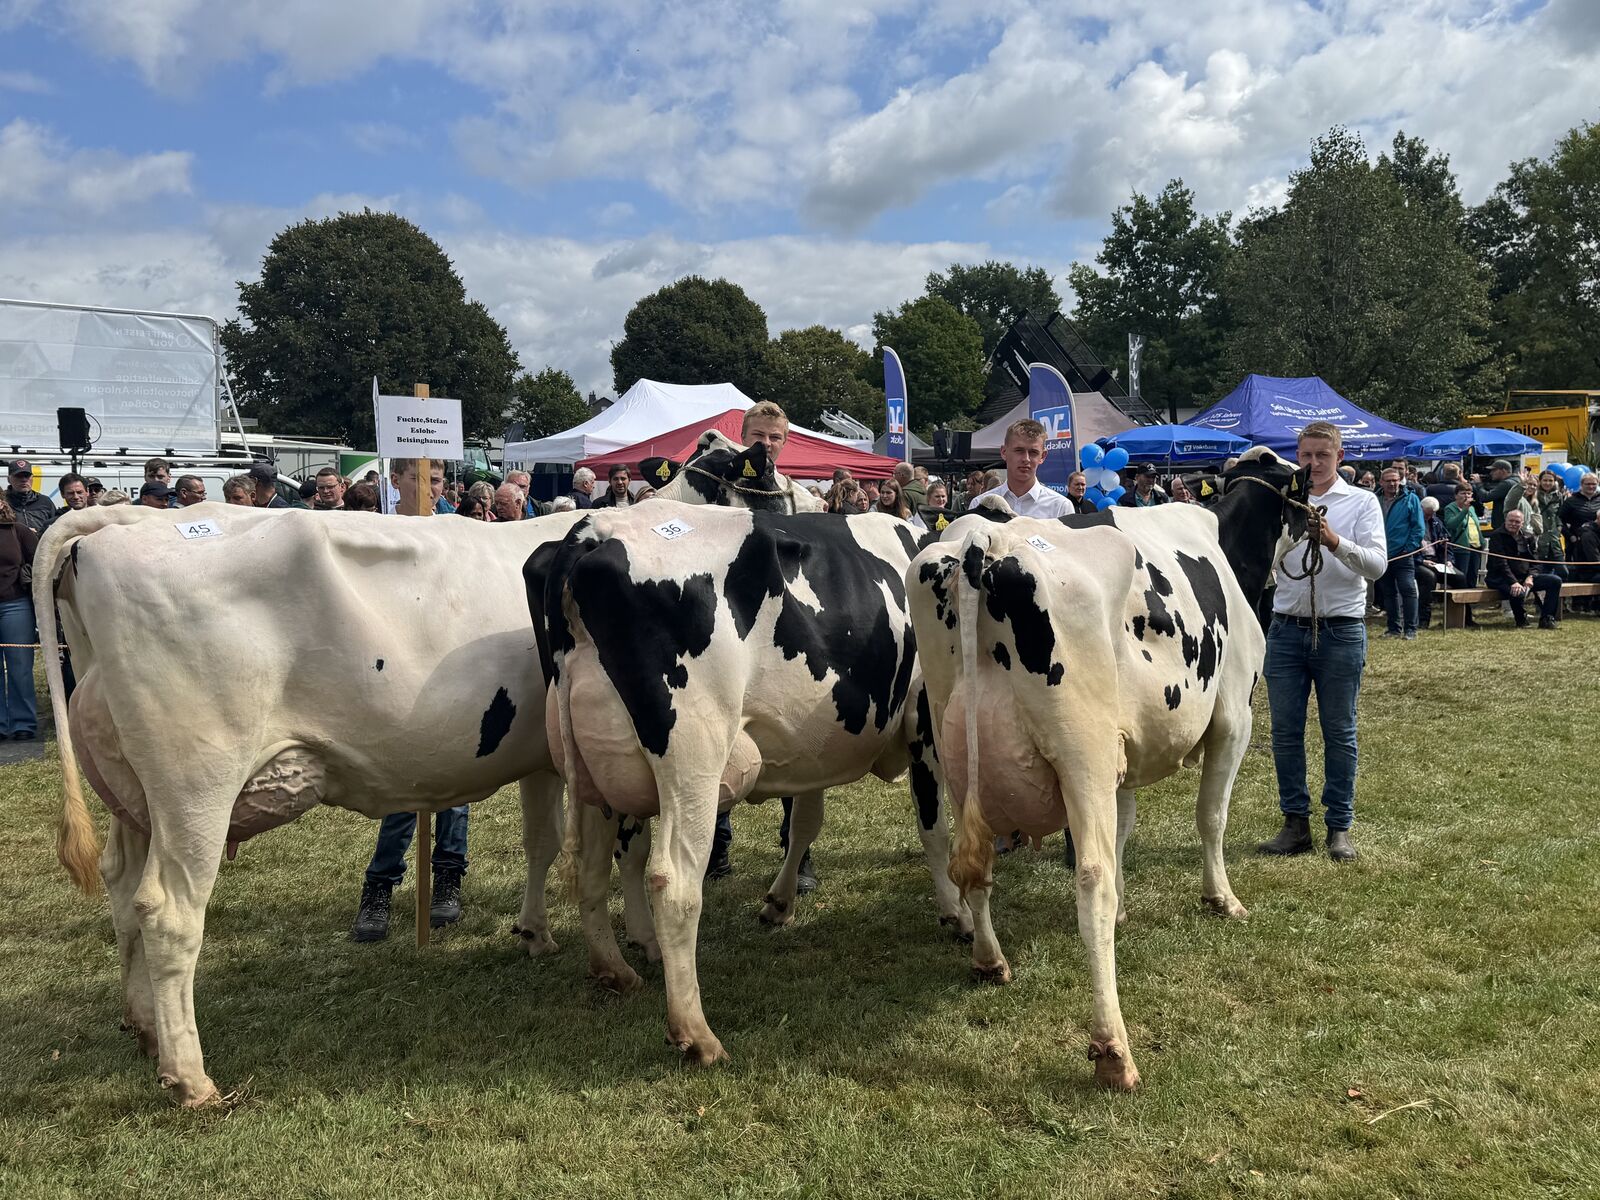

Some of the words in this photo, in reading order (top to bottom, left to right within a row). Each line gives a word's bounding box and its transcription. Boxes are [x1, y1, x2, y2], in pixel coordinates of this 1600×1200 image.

[396, 436, 449, 445] Beisinghausen
[188, 524, 211, 535] 45
[660, 523, 682, 536] 36
